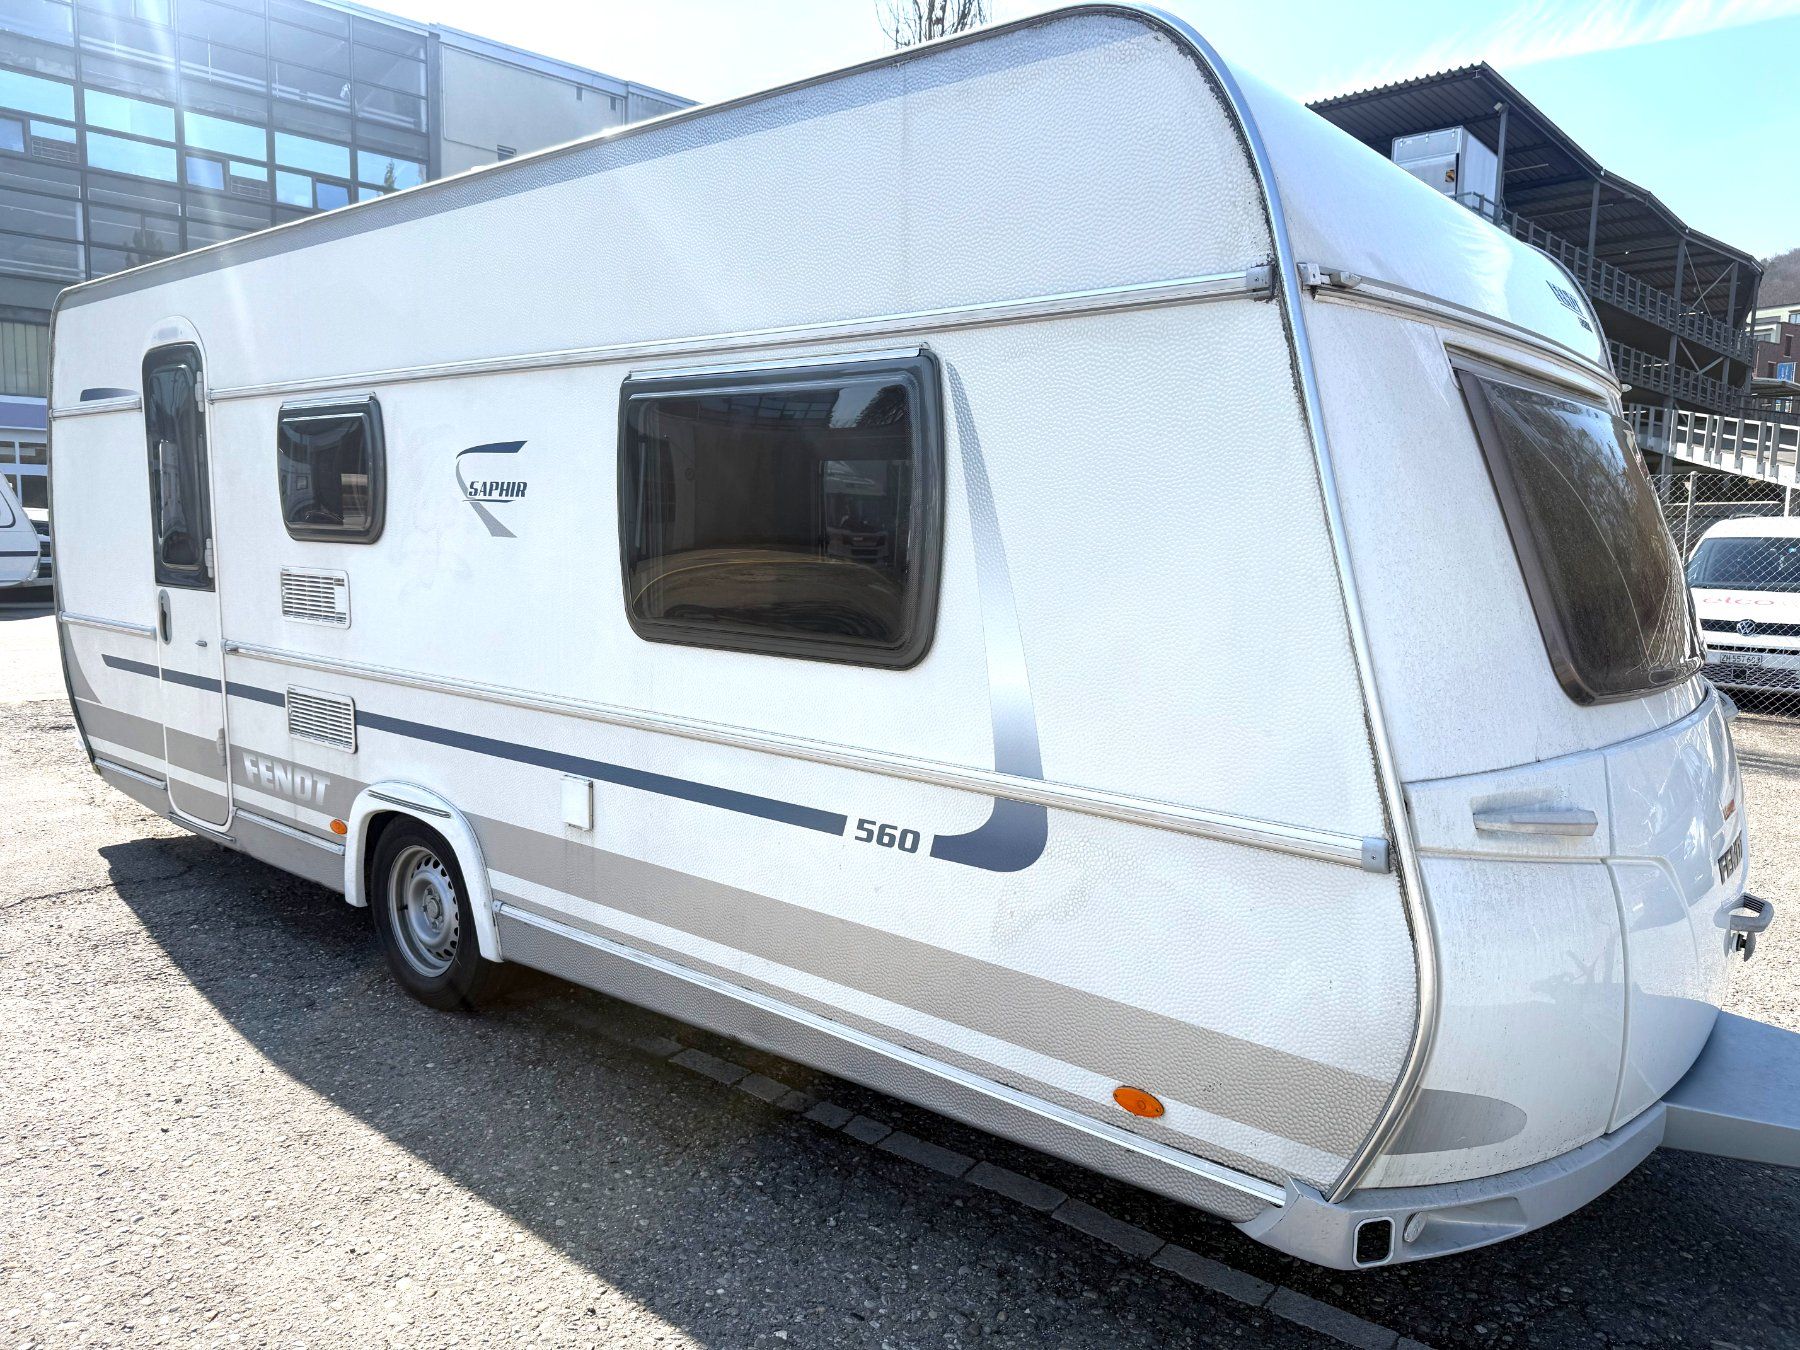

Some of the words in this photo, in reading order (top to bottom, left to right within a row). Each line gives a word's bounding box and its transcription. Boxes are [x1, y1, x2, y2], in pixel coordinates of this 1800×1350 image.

[468, 480, 528, 498] SAPHIR
[242, 751, 331, 806] FENDT
[854, 817, 921, 854] 560
